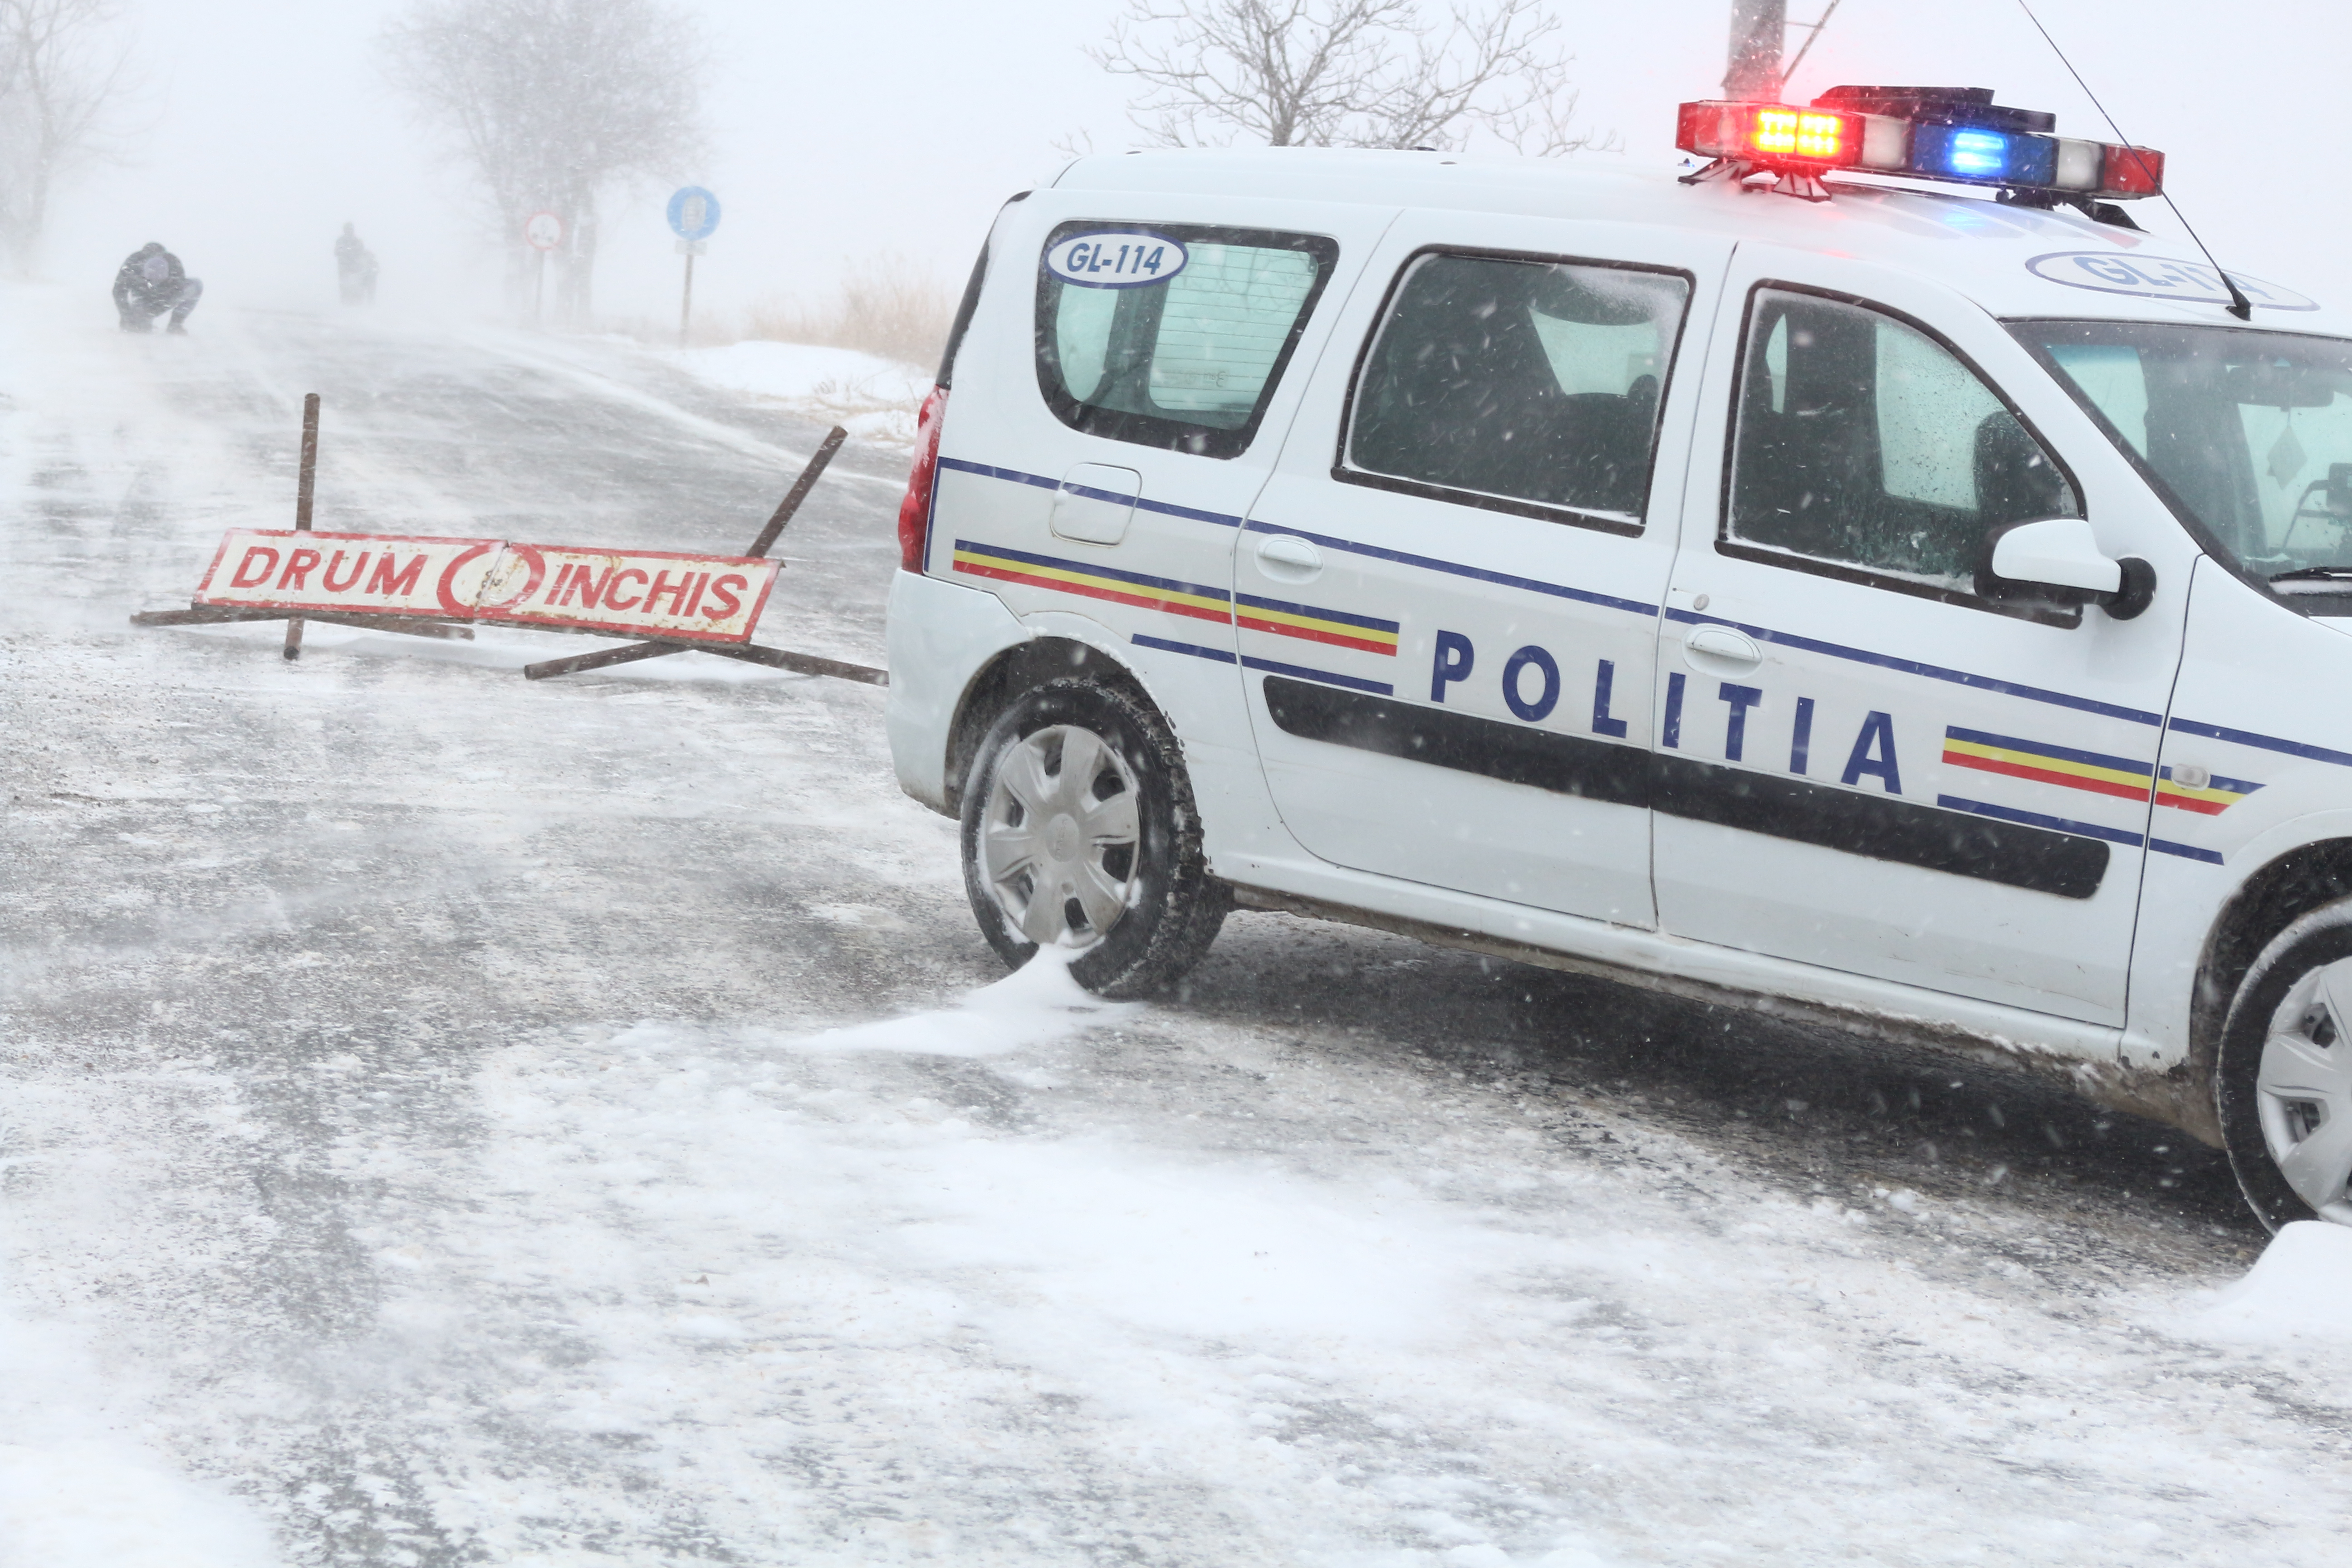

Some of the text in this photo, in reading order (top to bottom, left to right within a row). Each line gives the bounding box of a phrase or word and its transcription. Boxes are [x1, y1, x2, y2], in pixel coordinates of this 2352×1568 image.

[1066, 243, 1165, 275] GL-114
[230, 545, 749, 622] DRUM INCHIS
[1431, 630, 1901, 795] POLITIA
